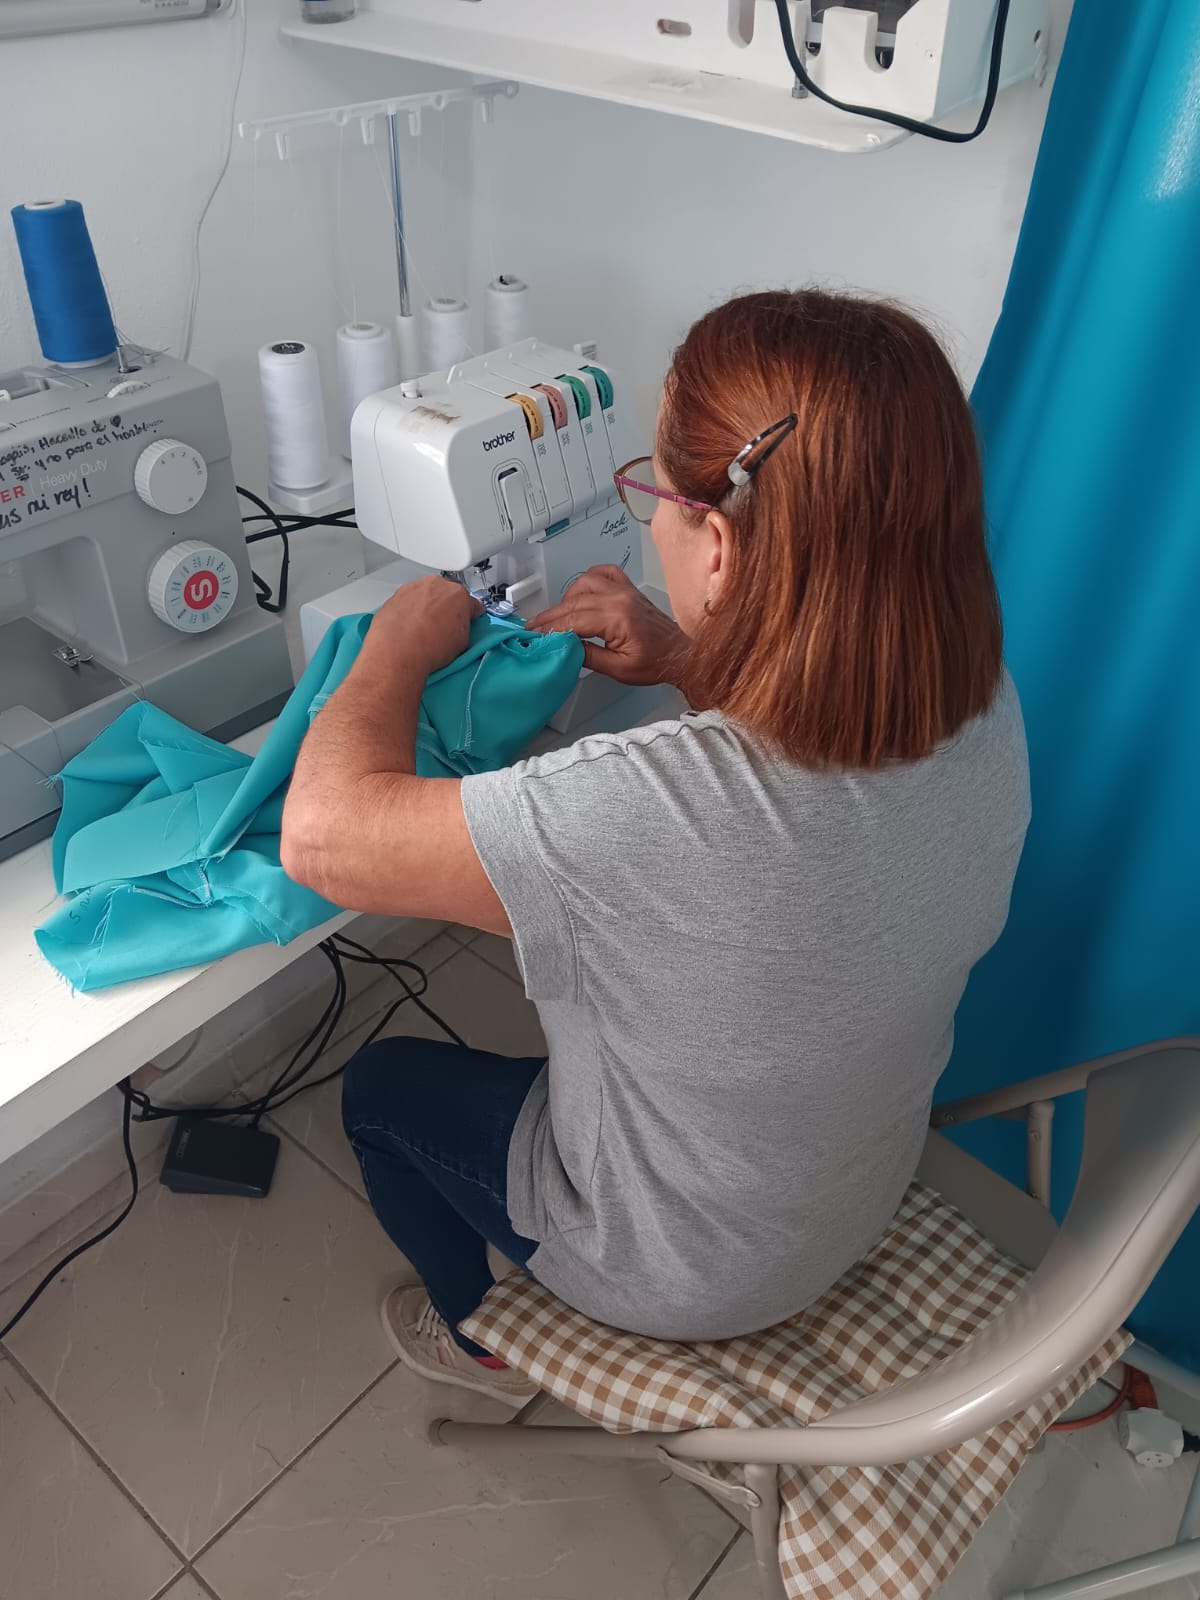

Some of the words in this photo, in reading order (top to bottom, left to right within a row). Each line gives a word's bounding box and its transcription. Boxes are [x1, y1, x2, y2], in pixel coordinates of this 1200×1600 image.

[482, 430, 515, 452] brother
[40, 468, 78, 489] Heavy
[80, 458, 108, 476] Duty
[600, 511, 629, 536] Lock
